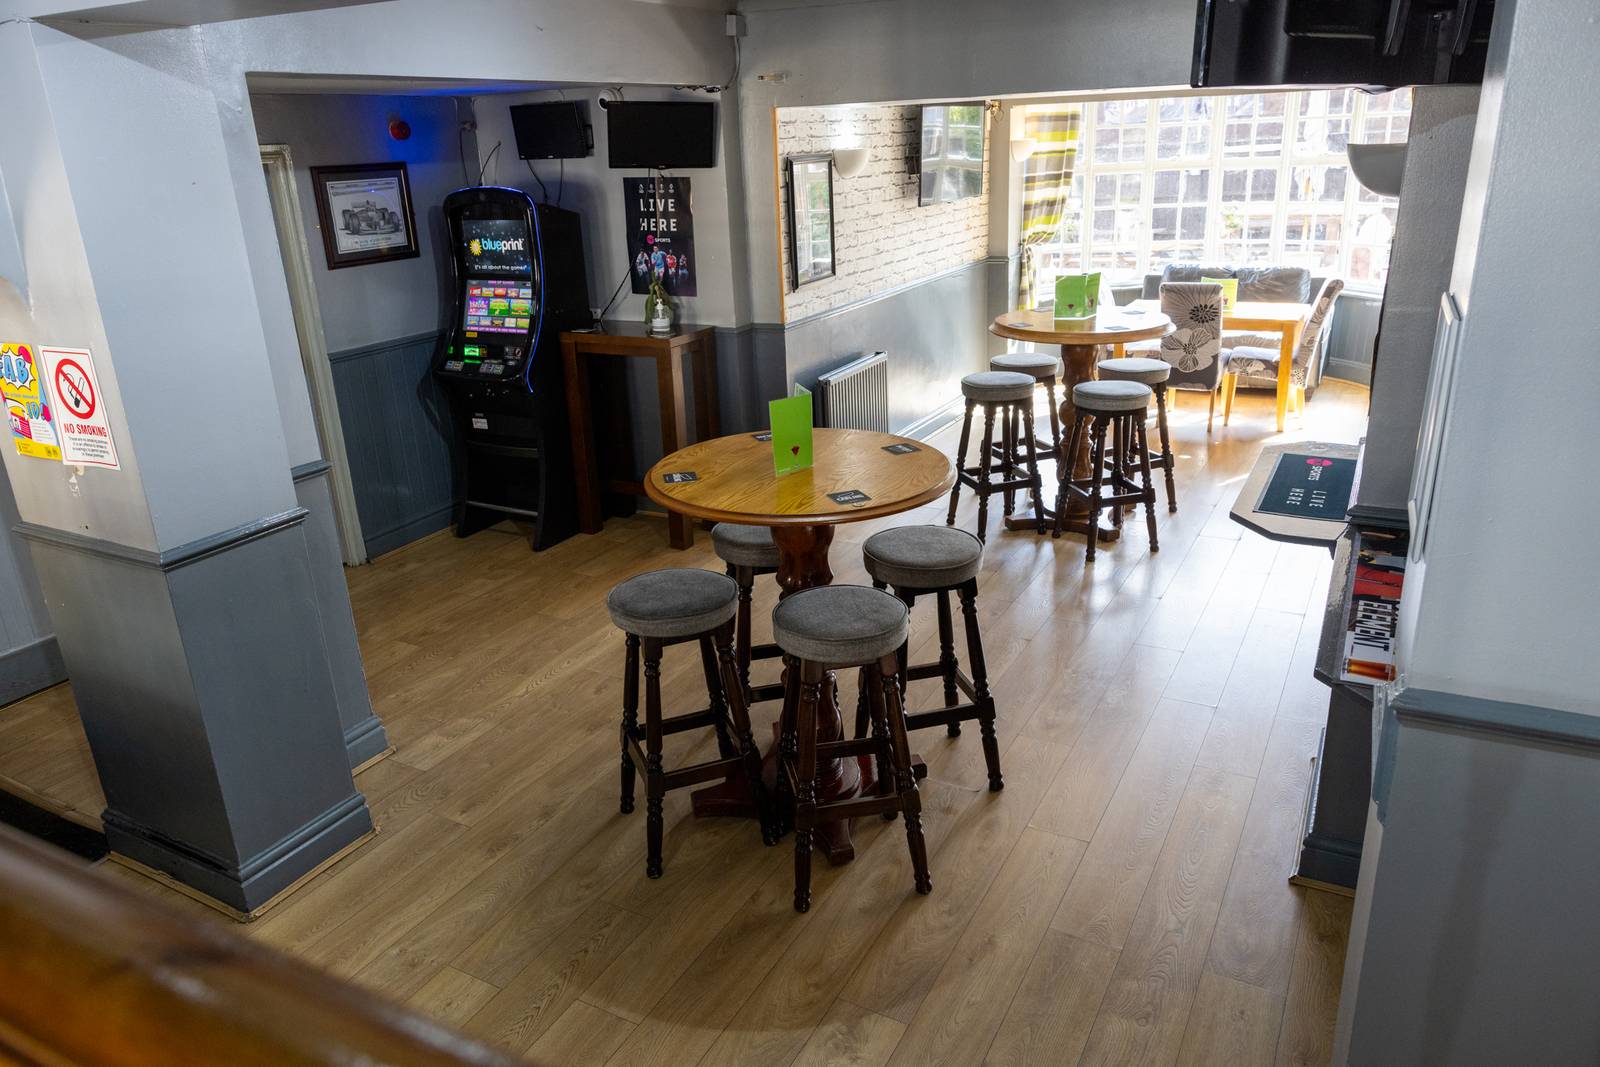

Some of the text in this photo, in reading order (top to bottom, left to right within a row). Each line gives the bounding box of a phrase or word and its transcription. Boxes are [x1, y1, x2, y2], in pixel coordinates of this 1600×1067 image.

[640, 199, 675, 212] LIVE
[640, 218, 677, 231] HERE
[482, 238, 524, 253] blueprint
[63, 423, 75, 434] NO
[76, 424, 107, 437] SMOKING
[1286, 488, 1305, 505] HERE
[1309, 490, 1327, 508] LIVE
[1353, 600, 1393, 652] ELEMENT
